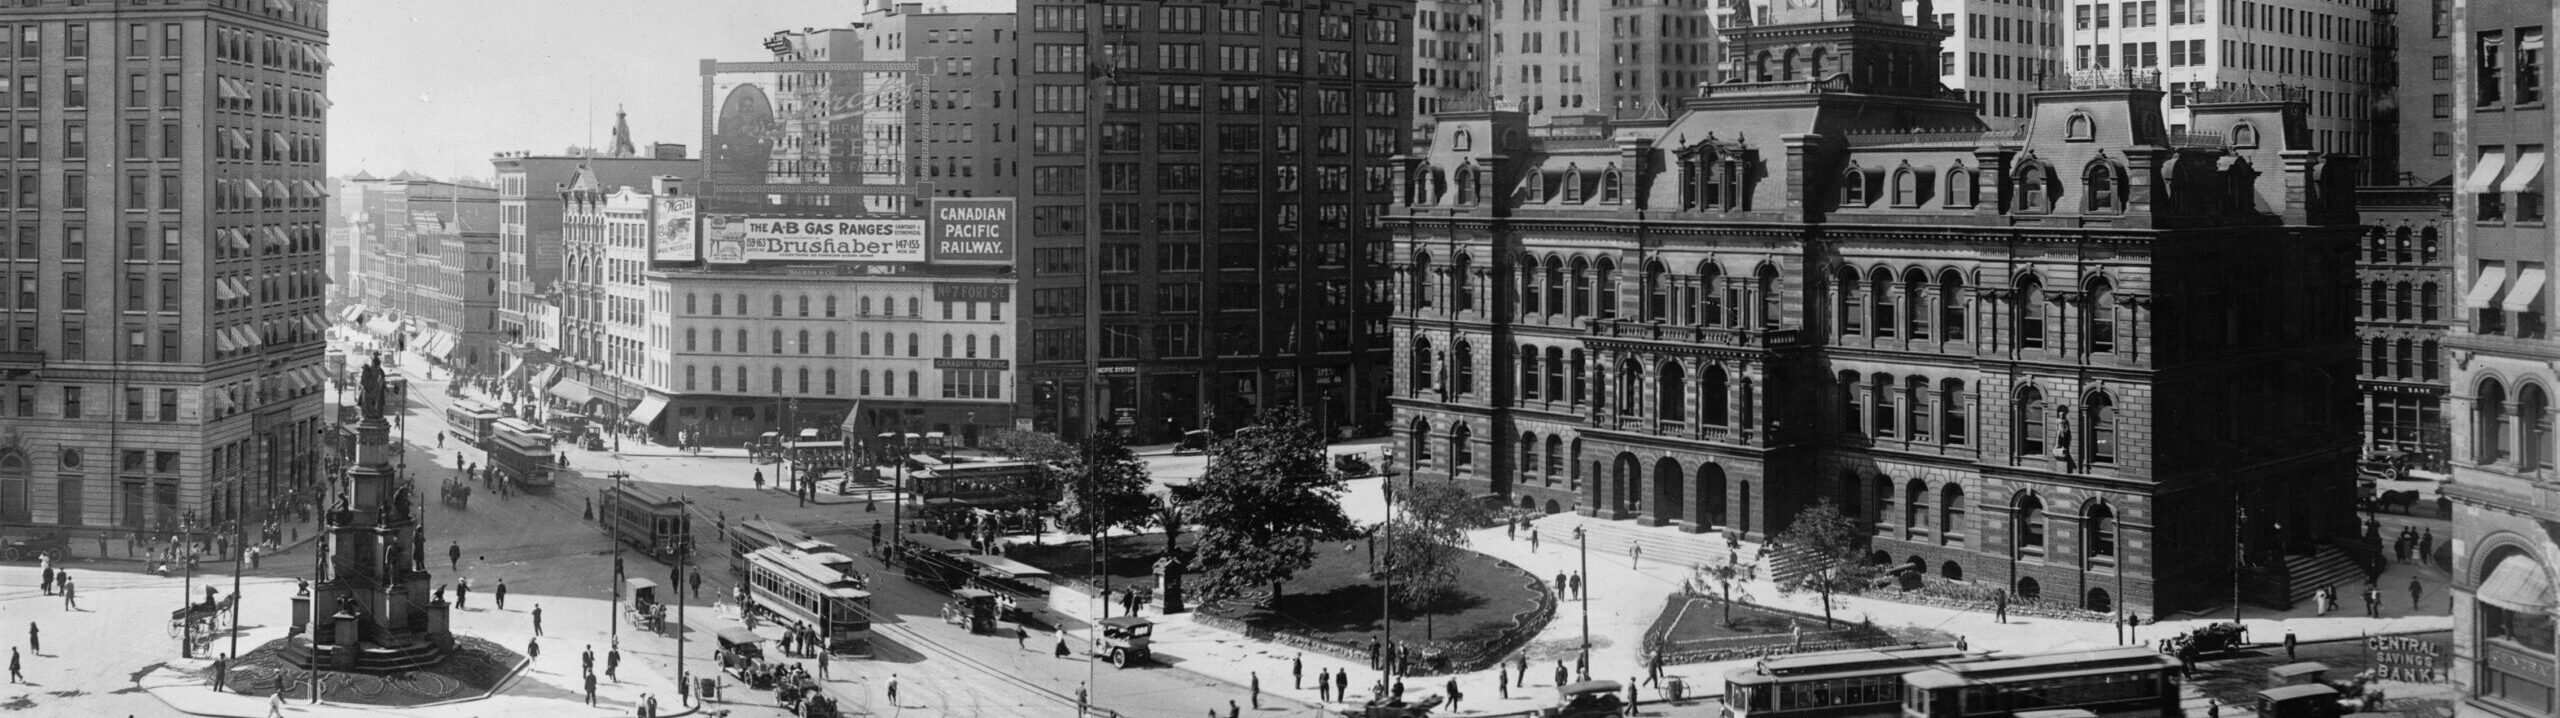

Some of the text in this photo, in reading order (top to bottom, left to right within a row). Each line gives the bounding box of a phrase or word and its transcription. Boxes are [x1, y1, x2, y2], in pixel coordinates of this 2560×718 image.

[940, 207, 1006, 221] CANADIAN
[750, 223, 768, 233] THE
[804, 222, 834, 235] GAS
[839, 222, 894, 236] RANGES
[945, 224, 999, 238] PACIFIC
[766, 237, 894, 254] Brushaber
[896, 239, 920, 249] 147-155
[941, 241, 1003, 254] RAILWAY.
[961, 285, 988, 299] FORT
[936, 359, 1007, 370] CANADIAN PACIFIC
[2368, 635, 2440, 658] CENTRAL
[2376, 651, 2433, 668] SAVINGS
[2378, 664, 2431, 683] BANK
